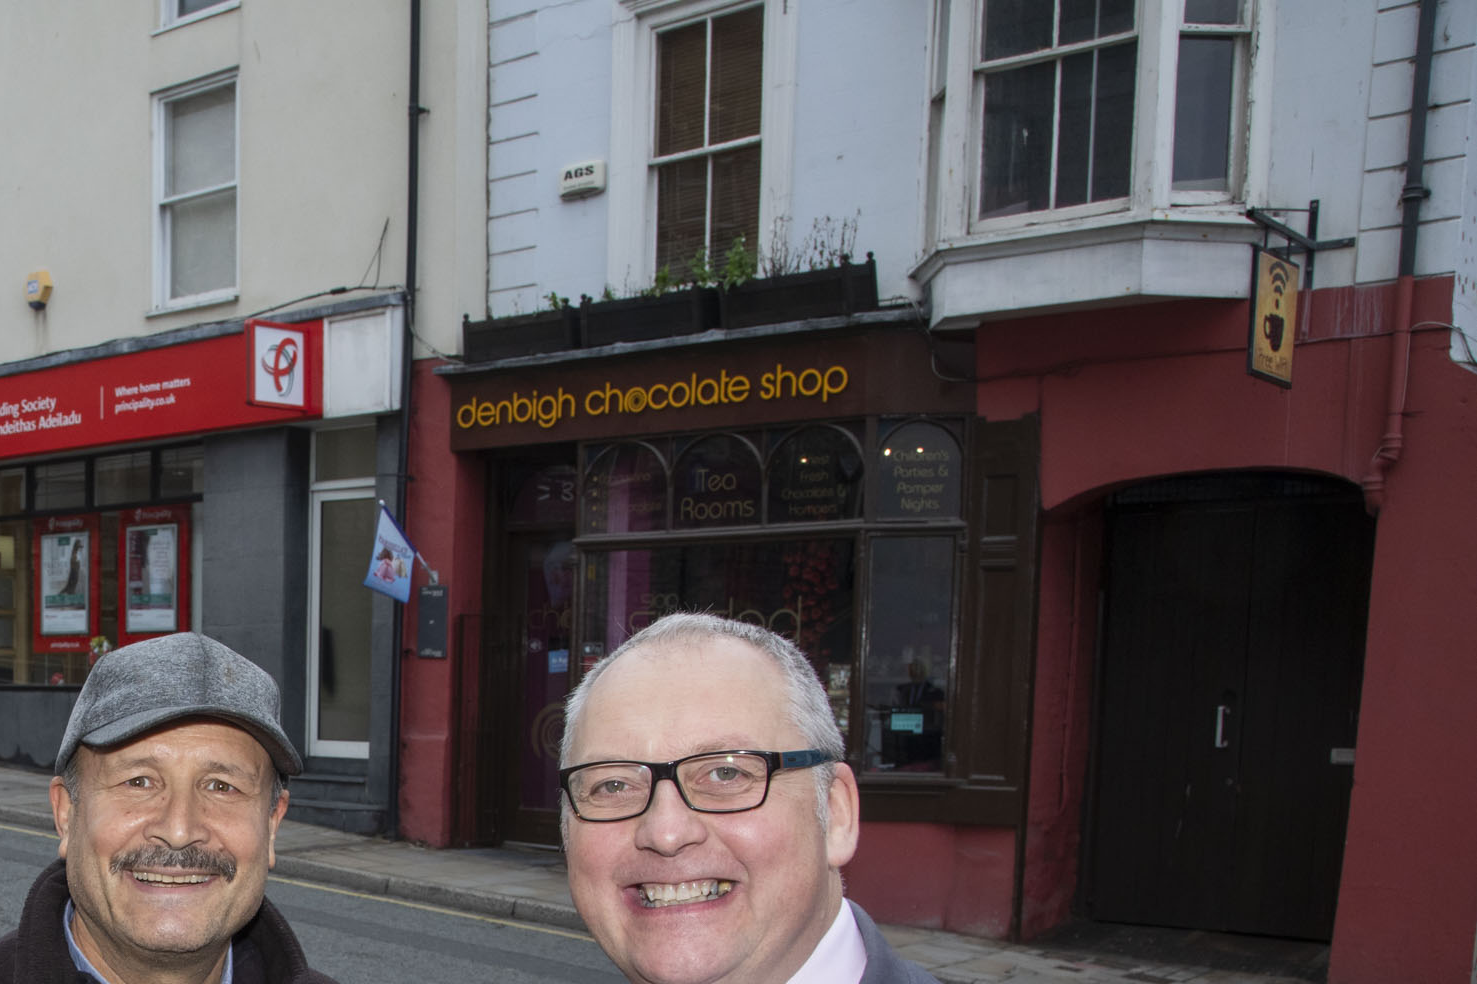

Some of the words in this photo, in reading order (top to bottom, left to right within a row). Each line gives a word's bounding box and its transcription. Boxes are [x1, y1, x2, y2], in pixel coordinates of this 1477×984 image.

[564, 165, 594, 181] AGS
[115, 385, 138, 397] Where
[139, 383, 160, 393] home
[162, 378, 190, 390] matters
[457, 387, 575, 429] denbigh
[585, 369, 750, 416] chocolate
[759, 363, 848, 403] shop
[21, 396, 57, 416] Society
[115, 393, 176, 415] principality.co.uk
[38, 410, 82, 429] Adeiladu
[696, 468, 737, 492] Tea
[680, 497, 755, 520] Rooms
[900, 496, 941, 512] Nights
